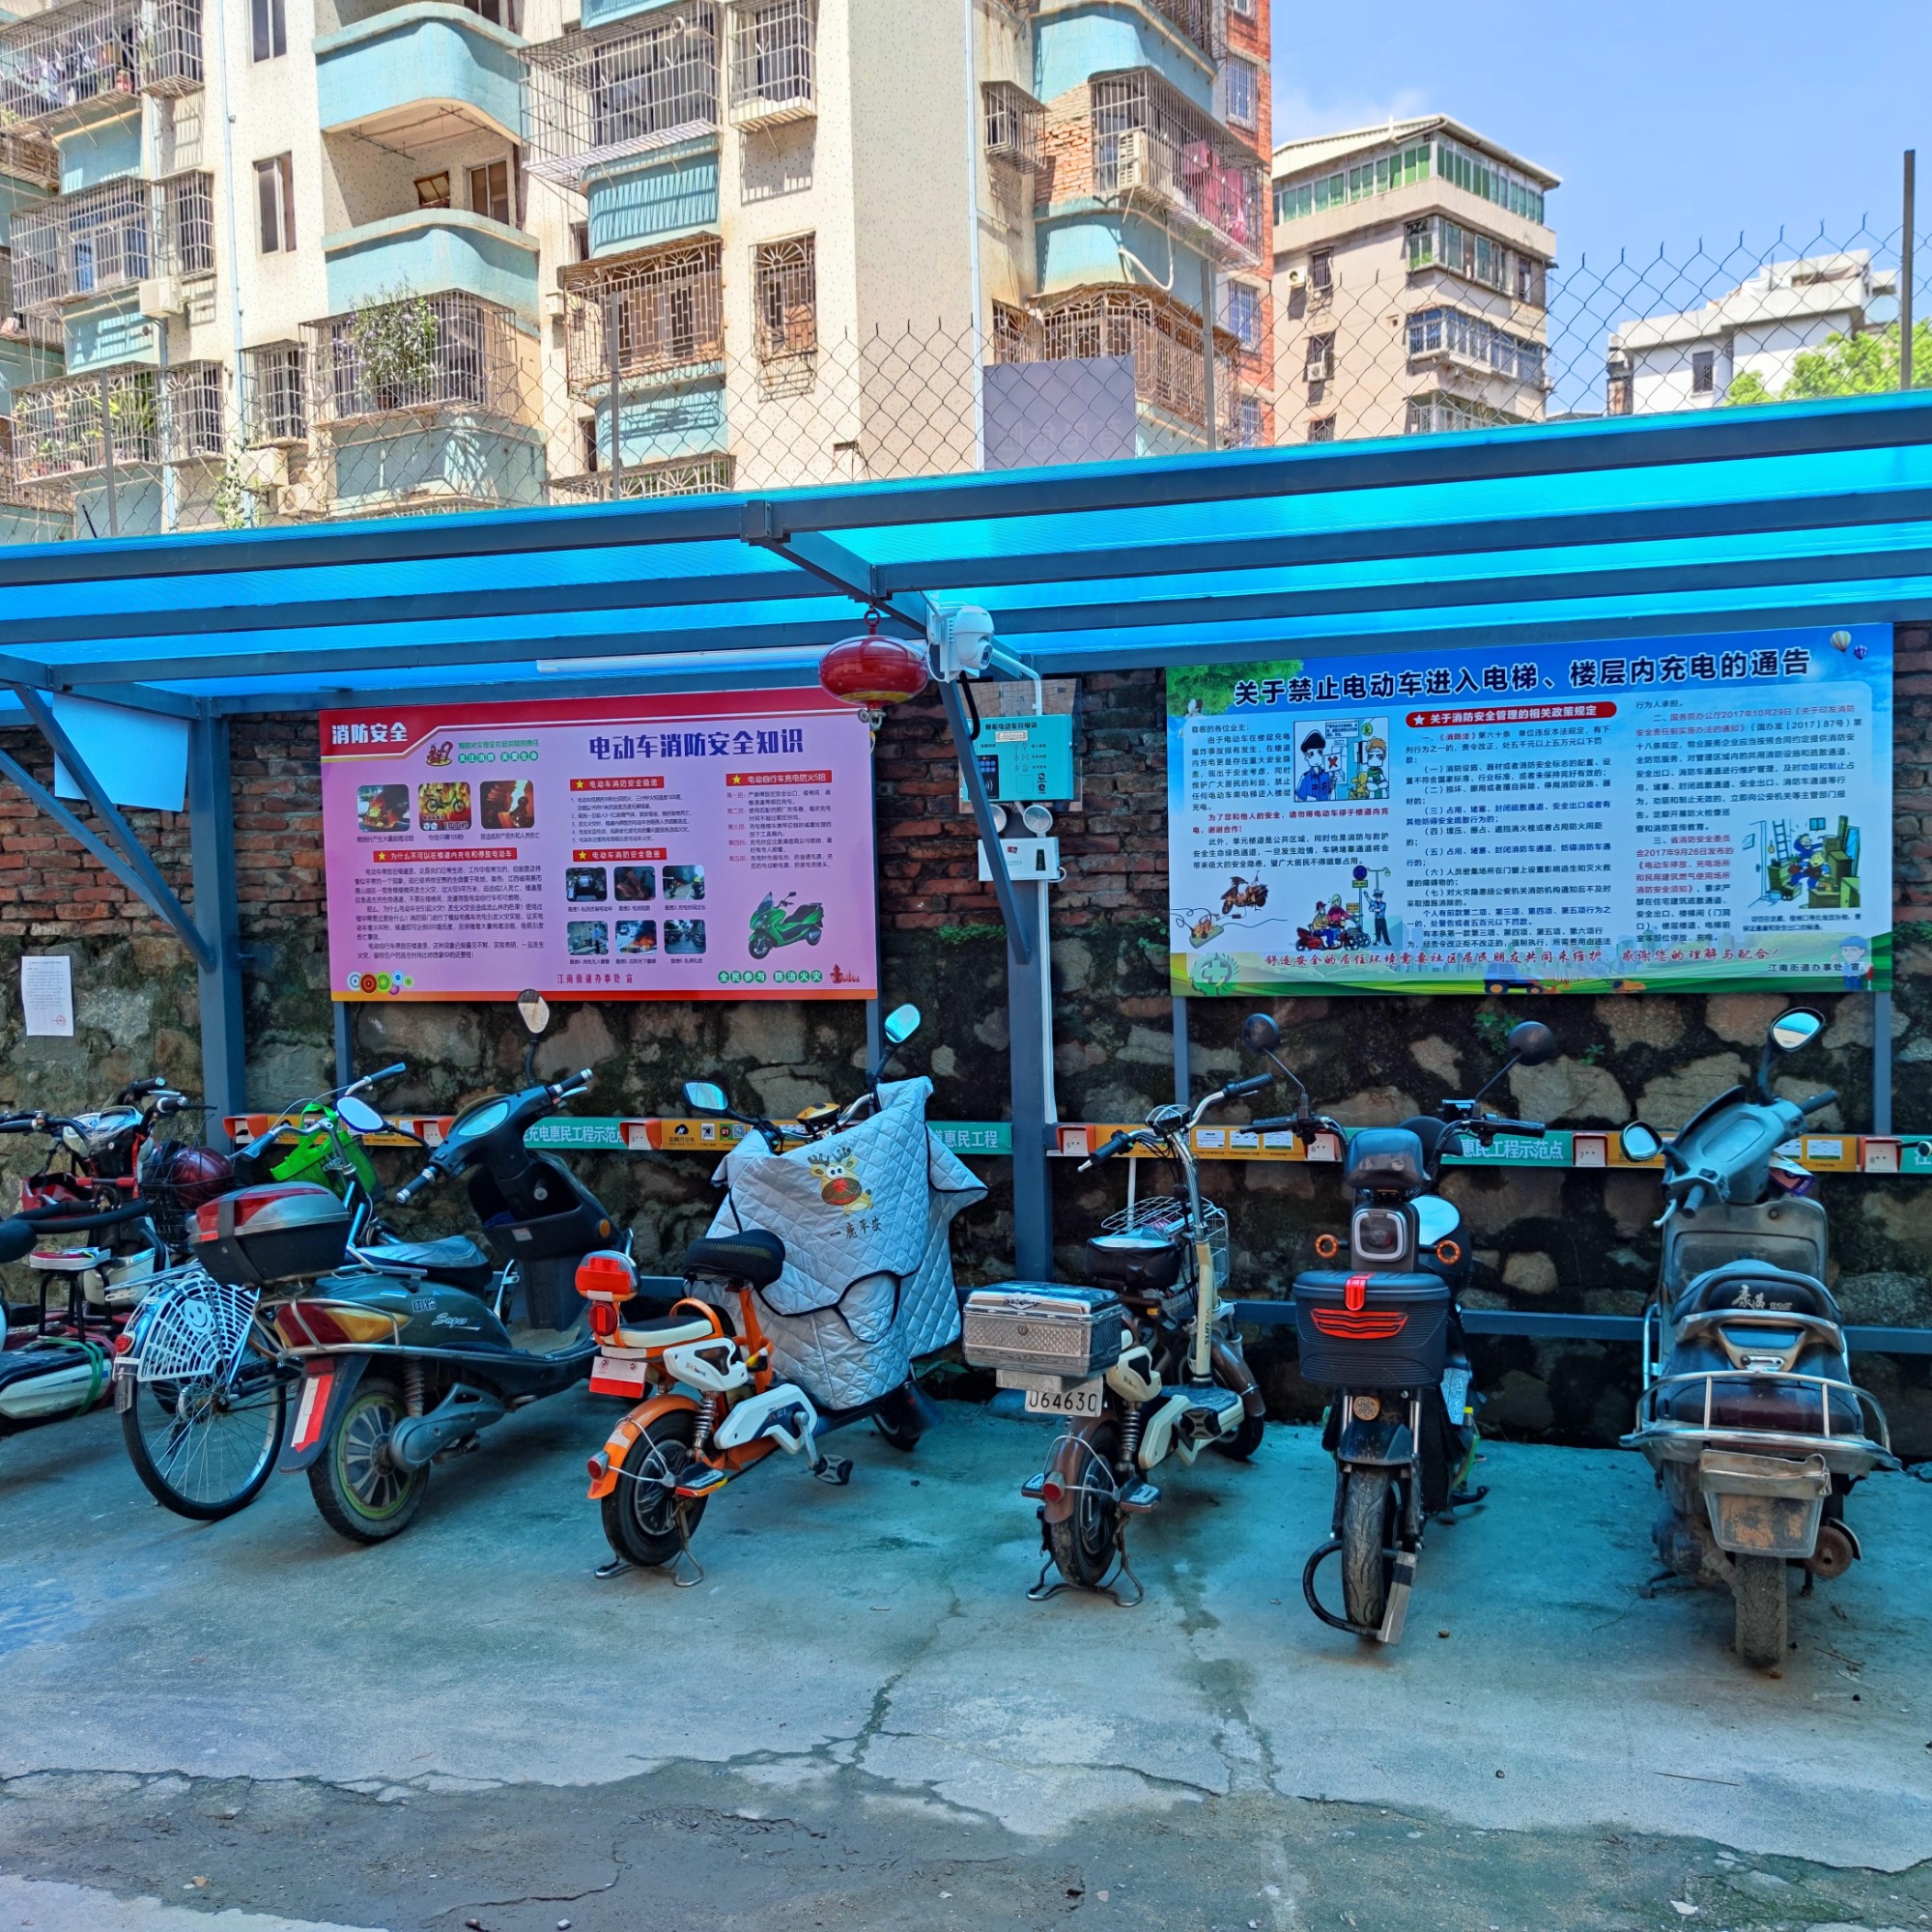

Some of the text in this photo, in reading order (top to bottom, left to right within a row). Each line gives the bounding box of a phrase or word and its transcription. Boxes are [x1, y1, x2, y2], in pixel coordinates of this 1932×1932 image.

[1235, 647, 1810, 706] 关于禁止电动车进入电梯、楼层内充电的通告
[1430, 704, 1597, 724] 关于消防安全管理的相关政策规定
[332, 723, 408, 745] 消防安全
[1208, 733, 1291, 744] 由于电动车在楼层充电
[589, 728, 804, 760] 电动车消防安全知识
[1192, 754, 1291, 767] 内充电更是存在重大安全隐
[589, 779, 658, 788] 电动车消防安全隐患
[748, 773, 826, 783] 电动自行车充电防火5招
[1192, 803, 1212, 811] 充电。
[390, 850, 512, 861] 为什么不可以在楼道内充电和停放电动车
[592, 849, 661, 859] 电动车消防安全隐患
[1635, 871, 1731, 883] 和民用建筑燃气使用场所
[1768, 963, 1842, 973] 江南街道办事处
[556, 973, 634, 984] 江南街道办事处 宣
[719, 970, 822, 982] 全民参与 防治火灾
[830, 1215, 882, 1240] 一鹿平安
